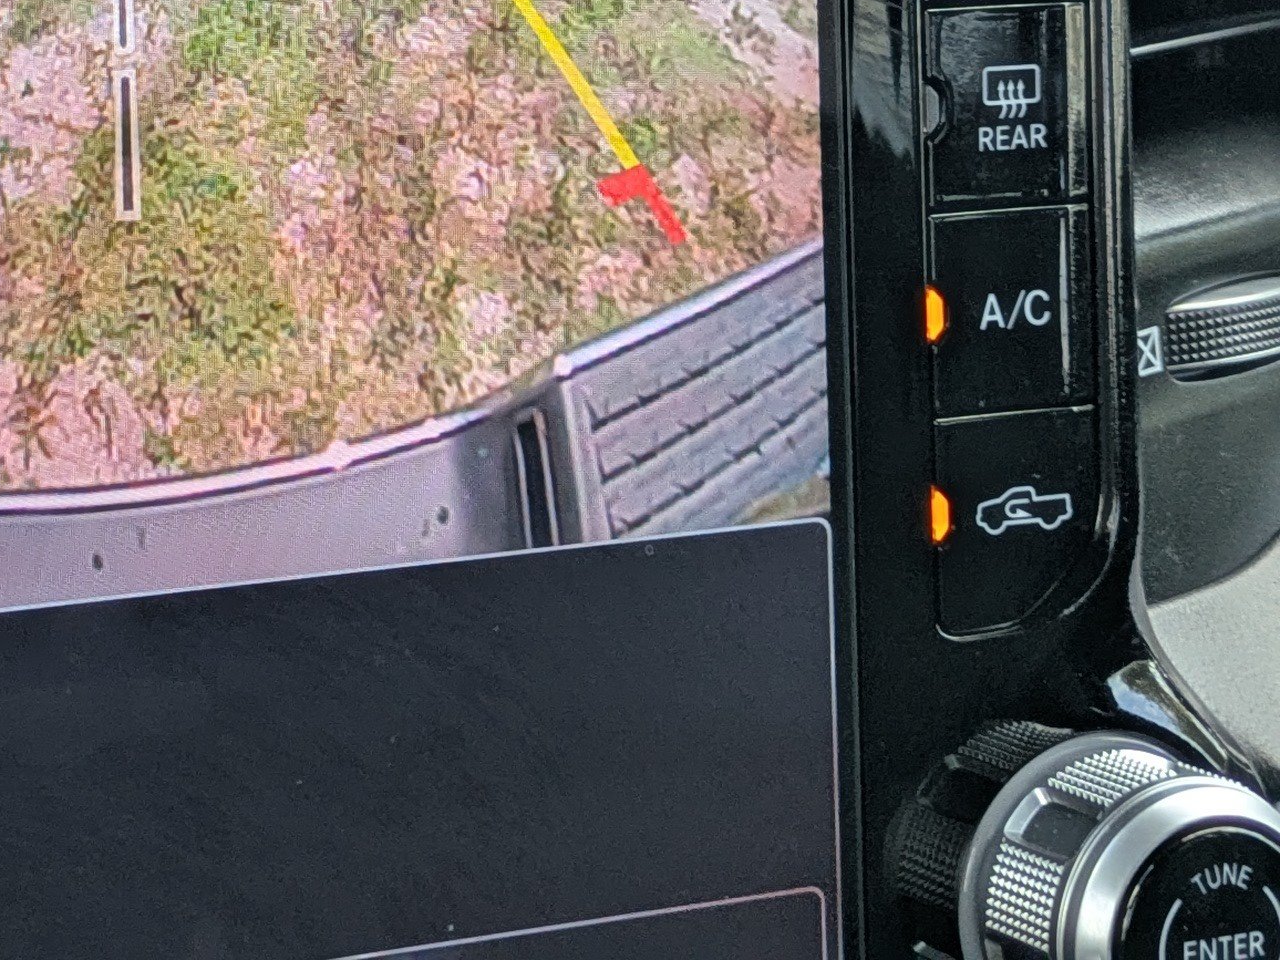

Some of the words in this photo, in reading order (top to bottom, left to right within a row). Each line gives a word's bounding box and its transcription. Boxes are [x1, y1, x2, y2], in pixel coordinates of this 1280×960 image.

[978, 124, 1048, 152] REAR
[979, 288, 1052, 330] A/C
[1190, 862, 1253, 895] TUNE
[1183, 930, 1265, 960] ENTER
